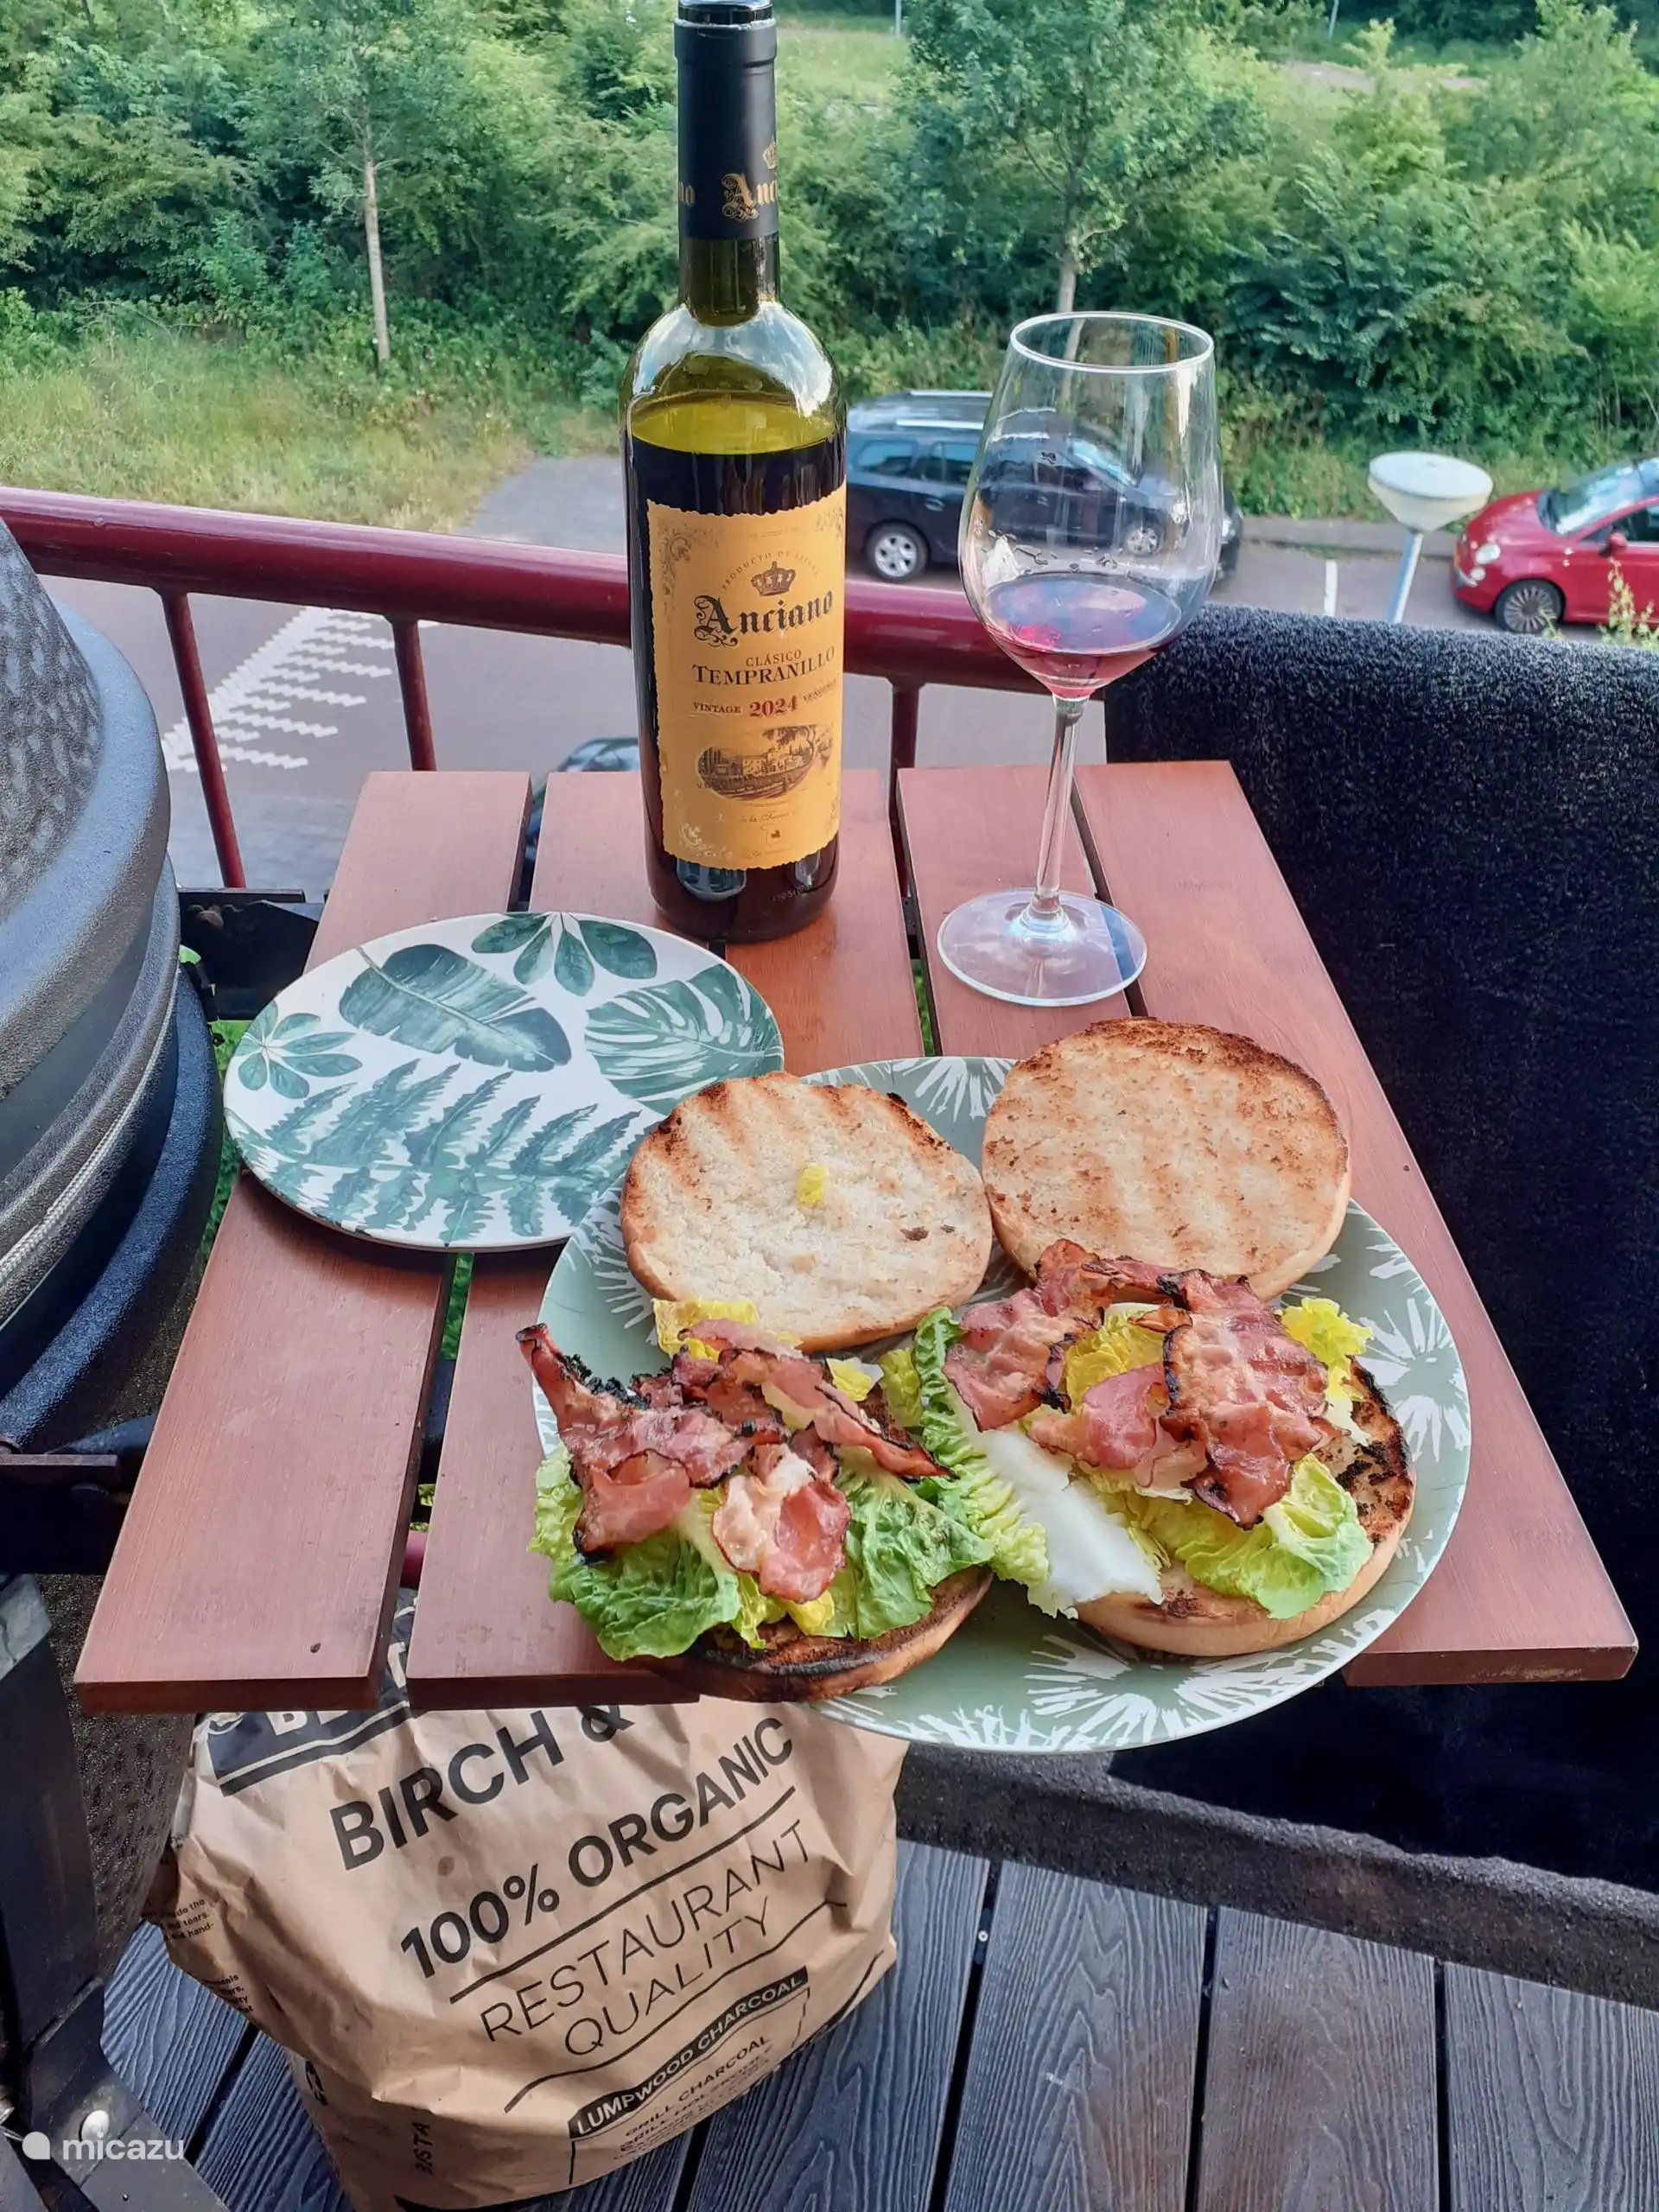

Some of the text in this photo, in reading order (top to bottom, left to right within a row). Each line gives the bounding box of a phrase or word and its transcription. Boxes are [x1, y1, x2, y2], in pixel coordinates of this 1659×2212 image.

[721, 552, 772, 591] PRODUCTO
[693, 590, 833, 648] Anciano
[692, 645, 835, 686] TEMPRANILLO
[746, 650, 802, 667] CLÁSICO
[692, 702, 741, 715] VINTAGE
[749, 696, 798, 717] 2024
[329, 1710, 564, 1872] BIRCH
[400, 1718, 794, 1979] 100% ORGANIC
[480, 1819, 809, 2043] RESTAURANT
[564, 1896, 770, 2056] QUALITY
[576, 2049, 694, 2135] LUMPWOOD
[697, 1976, 803, 2050] CHARCOAL
[678, 2036, 771, 2101] CHARCOAL
